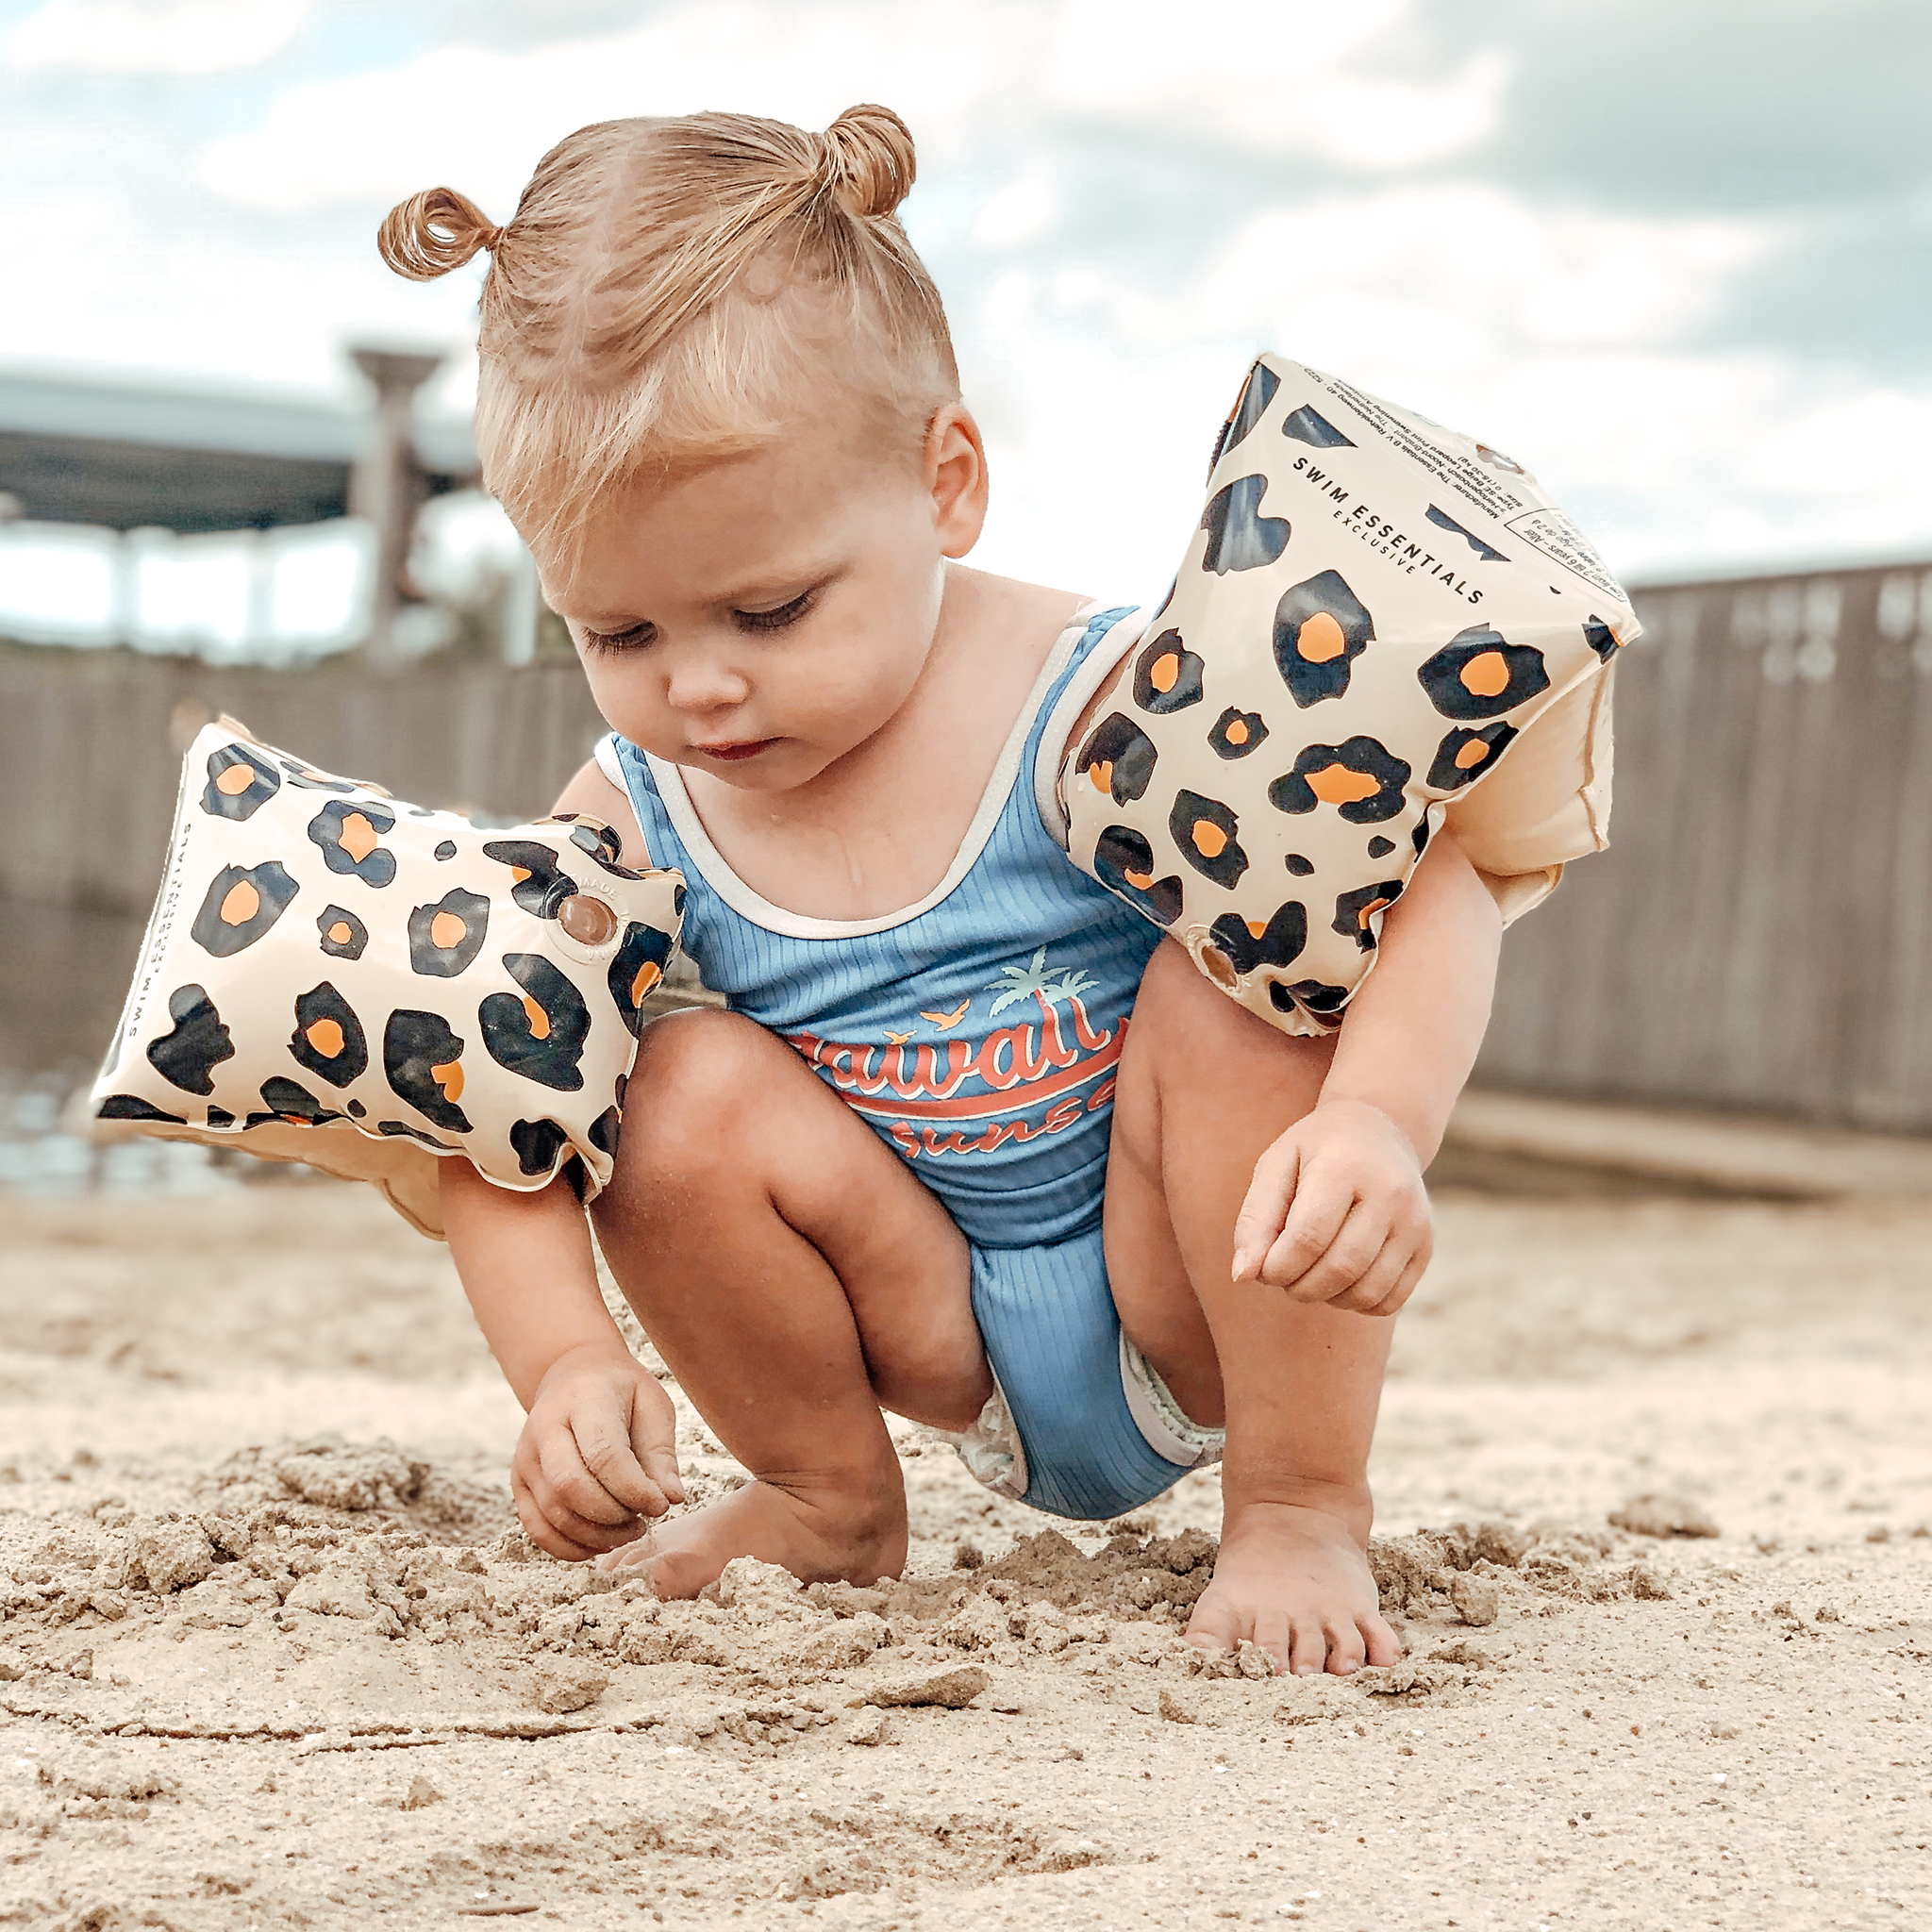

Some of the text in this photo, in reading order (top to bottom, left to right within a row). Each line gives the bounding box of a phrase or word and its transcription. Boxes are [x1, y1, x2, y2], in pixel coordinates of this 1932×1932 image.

[1326, 386, 1338, 394] 40
[1374, 405, 1411, 434] Swimming
[1411, 433, 1430, 447] Print
[1401, 445, 1437, 473] Essentials
[1430, 446, 1462, 469] Leopard
[1437, 471, 1451, 484] The
[1462, 469, 1484, 487] Beige
[1451, 482, 1500, 519] Manufacturer:
[1292, 457, 1349, 504] SWIM
[1352, 505, 1484, 604] ESSENTIALS
[1333, 509, 1416, 575] EXCLUSIVE
[1548, 544, 1574, 560] years
[578, 876, 619, 901] MADE
[128, 823, 192, 1038] SWIM ESSENTIALS
